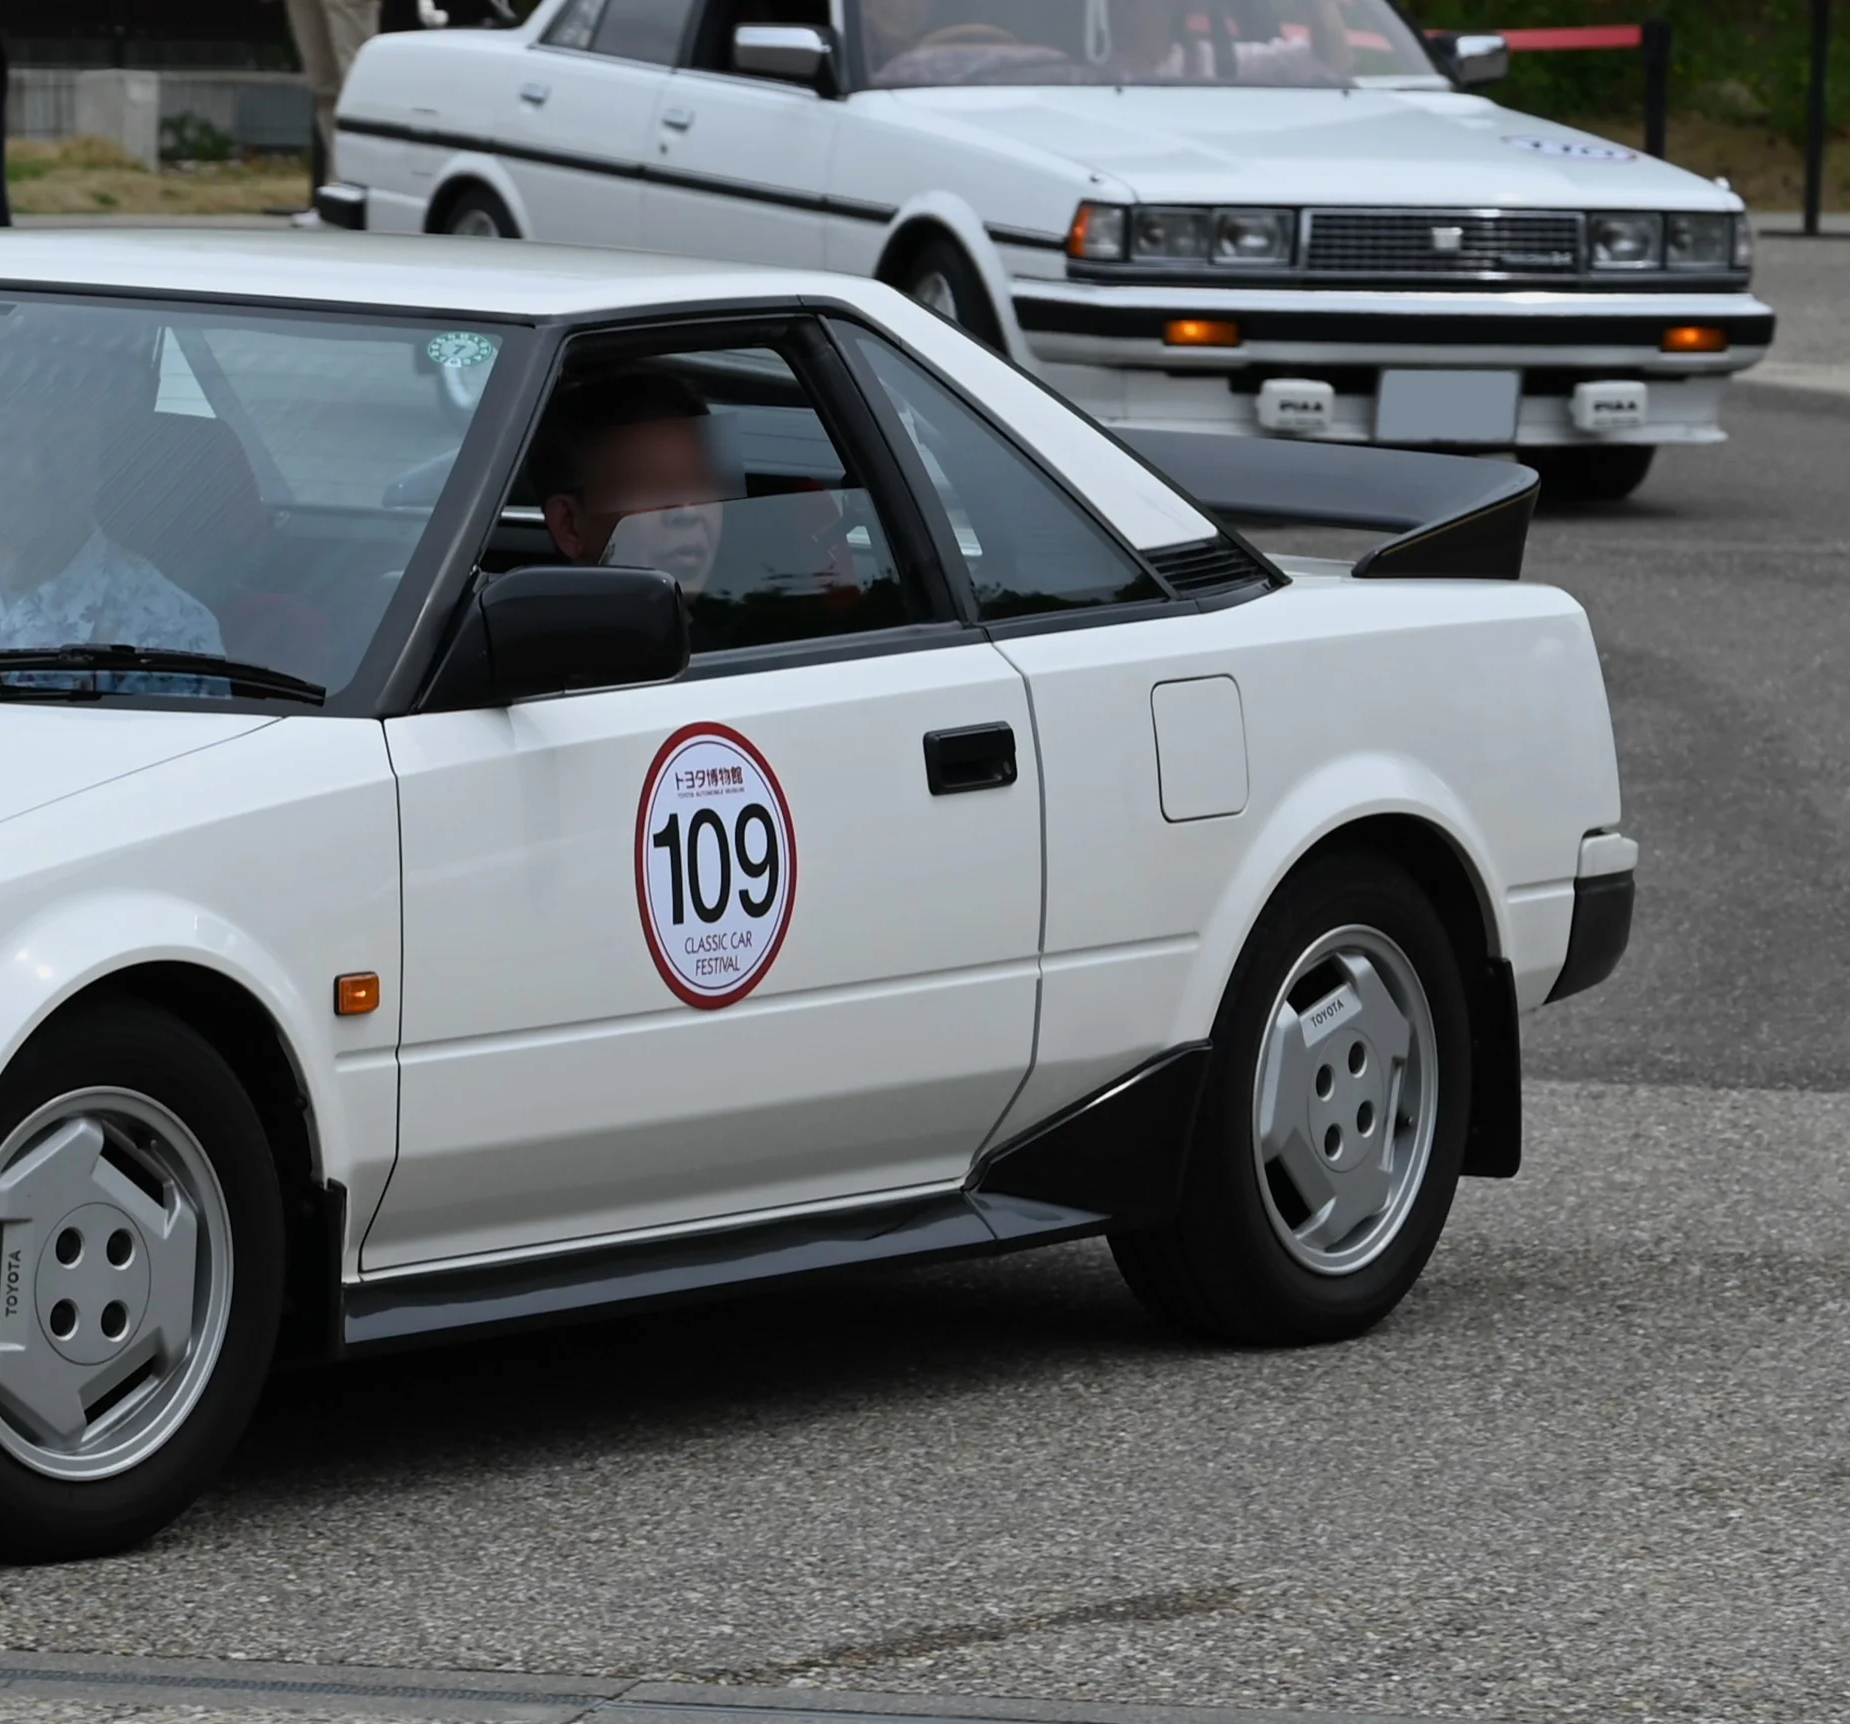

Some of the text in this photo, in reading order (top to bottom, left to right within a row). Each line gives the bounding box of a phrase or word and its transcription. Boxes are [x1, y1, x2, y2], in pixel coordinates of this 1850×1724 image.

[674, 766, 744, 791] トヨタ博物館
[653, 803, 779, 926] 109
[685, 930, 752, 955] CLASSIC CAR
[695, 955, 740, 976] FESTIVAL
[1311, 999, 1344, 1028] TOYOTA
[5, 1249, 22, 1318] TOYOTA
